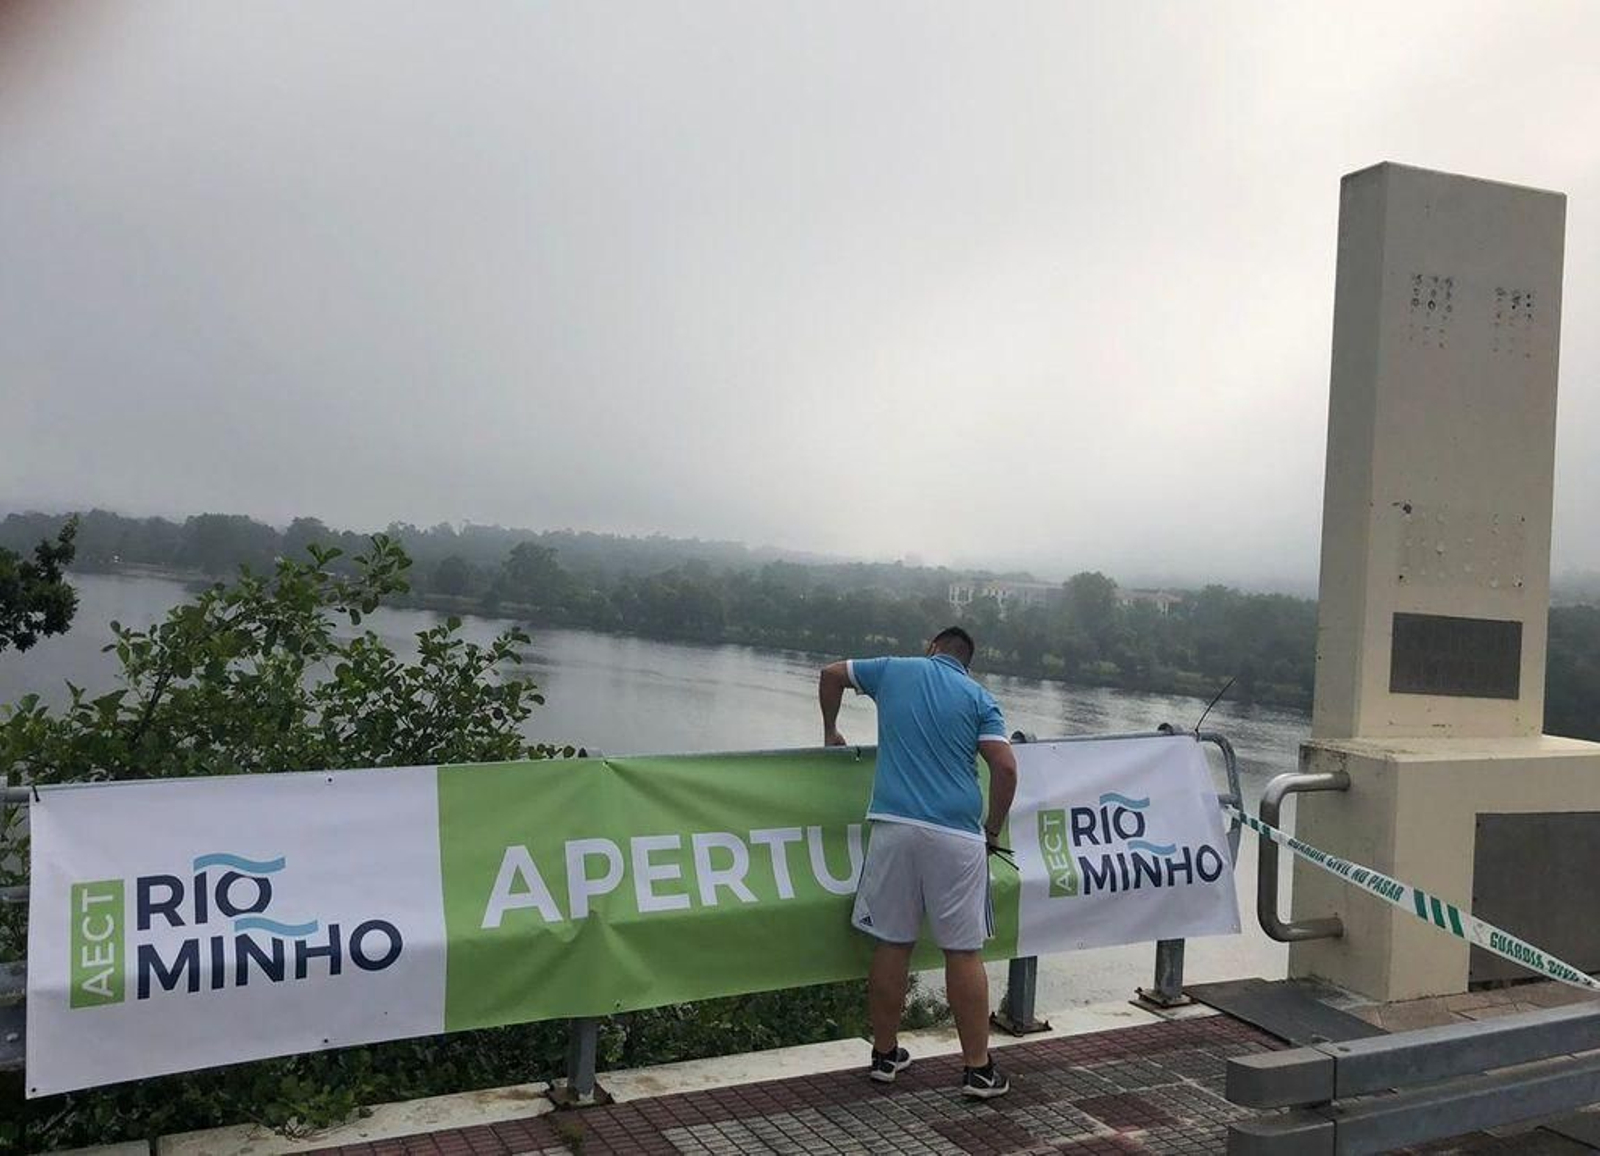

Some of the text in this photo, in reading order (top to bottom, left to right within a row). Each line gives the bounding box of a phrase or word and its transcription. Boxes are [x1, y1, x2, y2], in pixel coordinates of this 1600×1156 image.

[481, 824, 866, 929] APERTU
[1044, 814, 1072, 891] AECT
[1078, 845, 1222, 895] MINHO
[1326, 858, 1354, 876] CIVIL
[1351, 868, 1370, 884] NO
[1367, 874, 1405, 902] PASAR
[82, 888, 114, 998] AECT
[137, 919, 403, 1000] MINHO
[1489, 931, 1545, 970] GUARDIA
